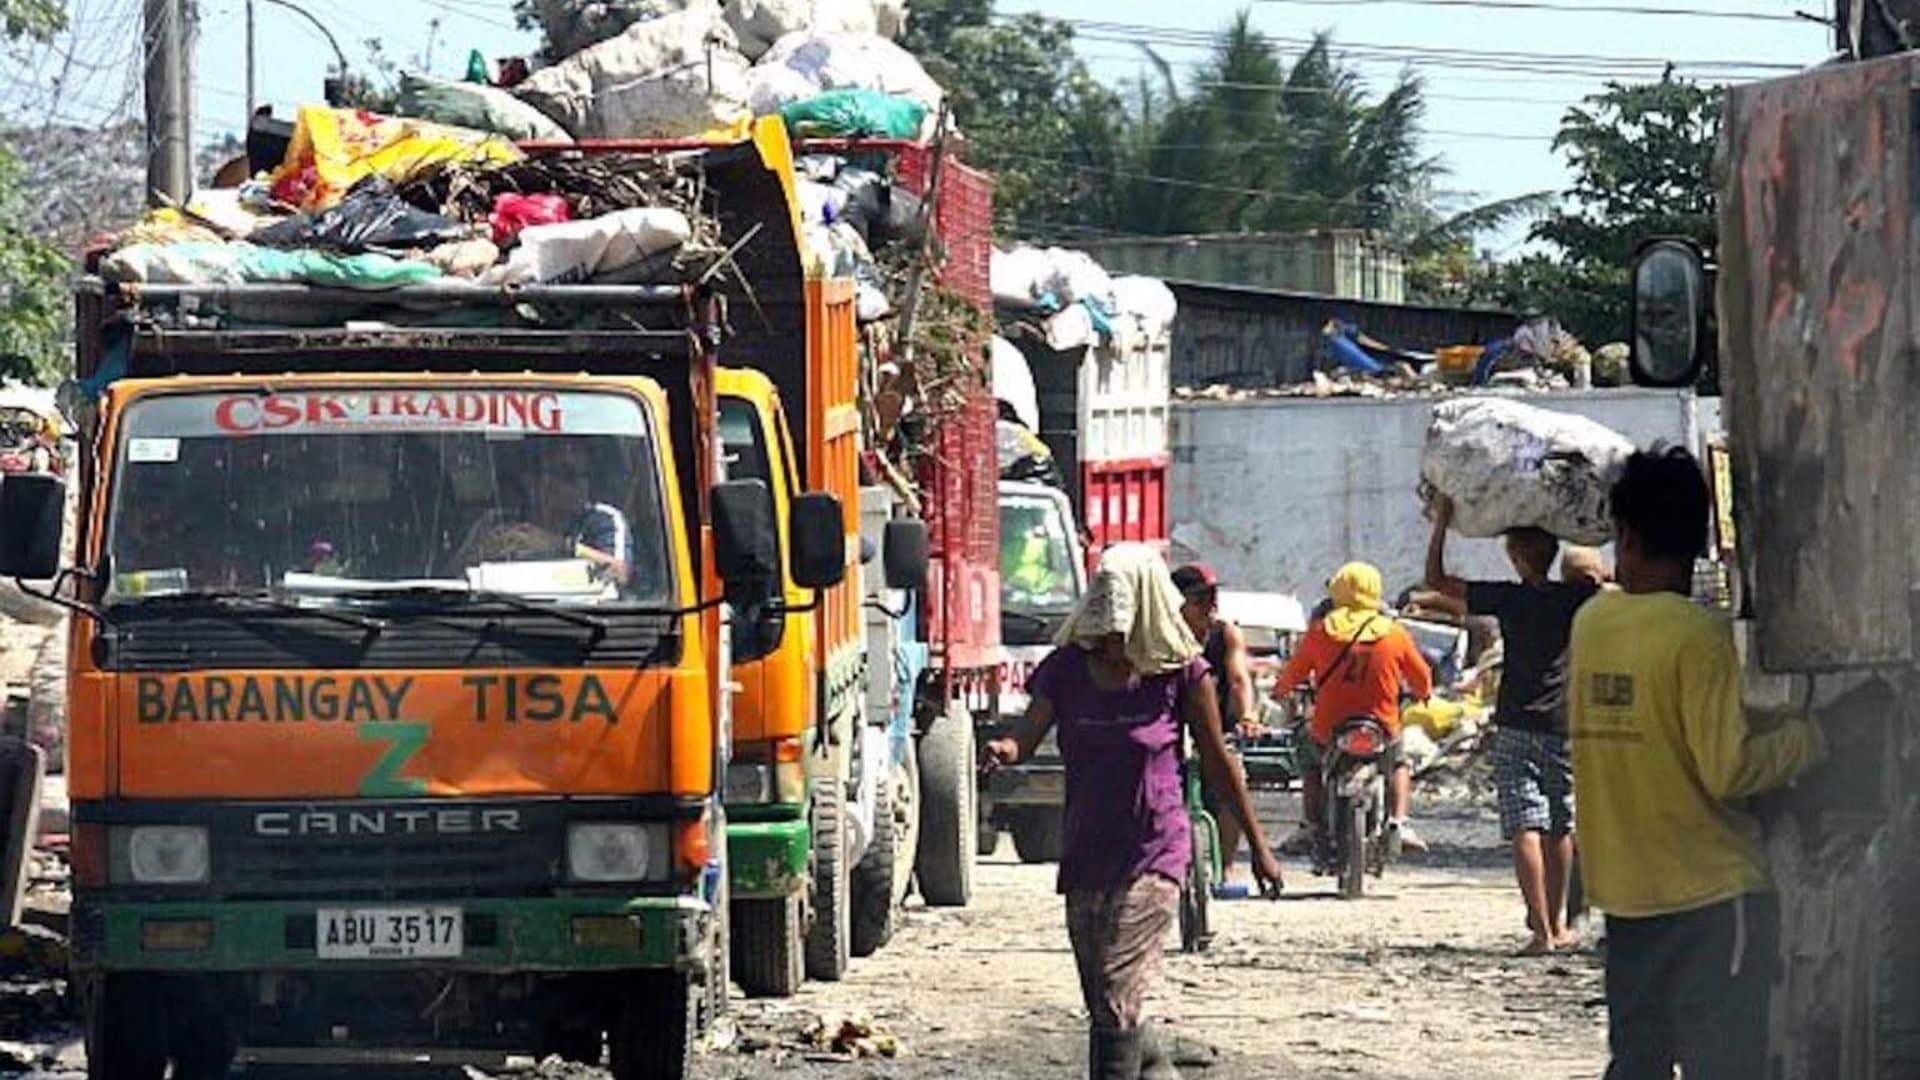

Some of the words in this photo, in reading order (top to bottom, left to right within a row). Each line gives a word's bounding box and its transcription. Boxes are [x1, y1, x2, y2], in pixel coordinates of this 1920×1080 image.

[214, 394, 350, 433] CSK
[367, 390, 564, 433] TRADING
[136, 674, 414, 724] BARANGAY
[462, 673, 619, 724] TISA
[254, 808, 522, 837] CANTER
[325, 915, 377, 946] ABU
[387, 914, 456, 945] 3517
